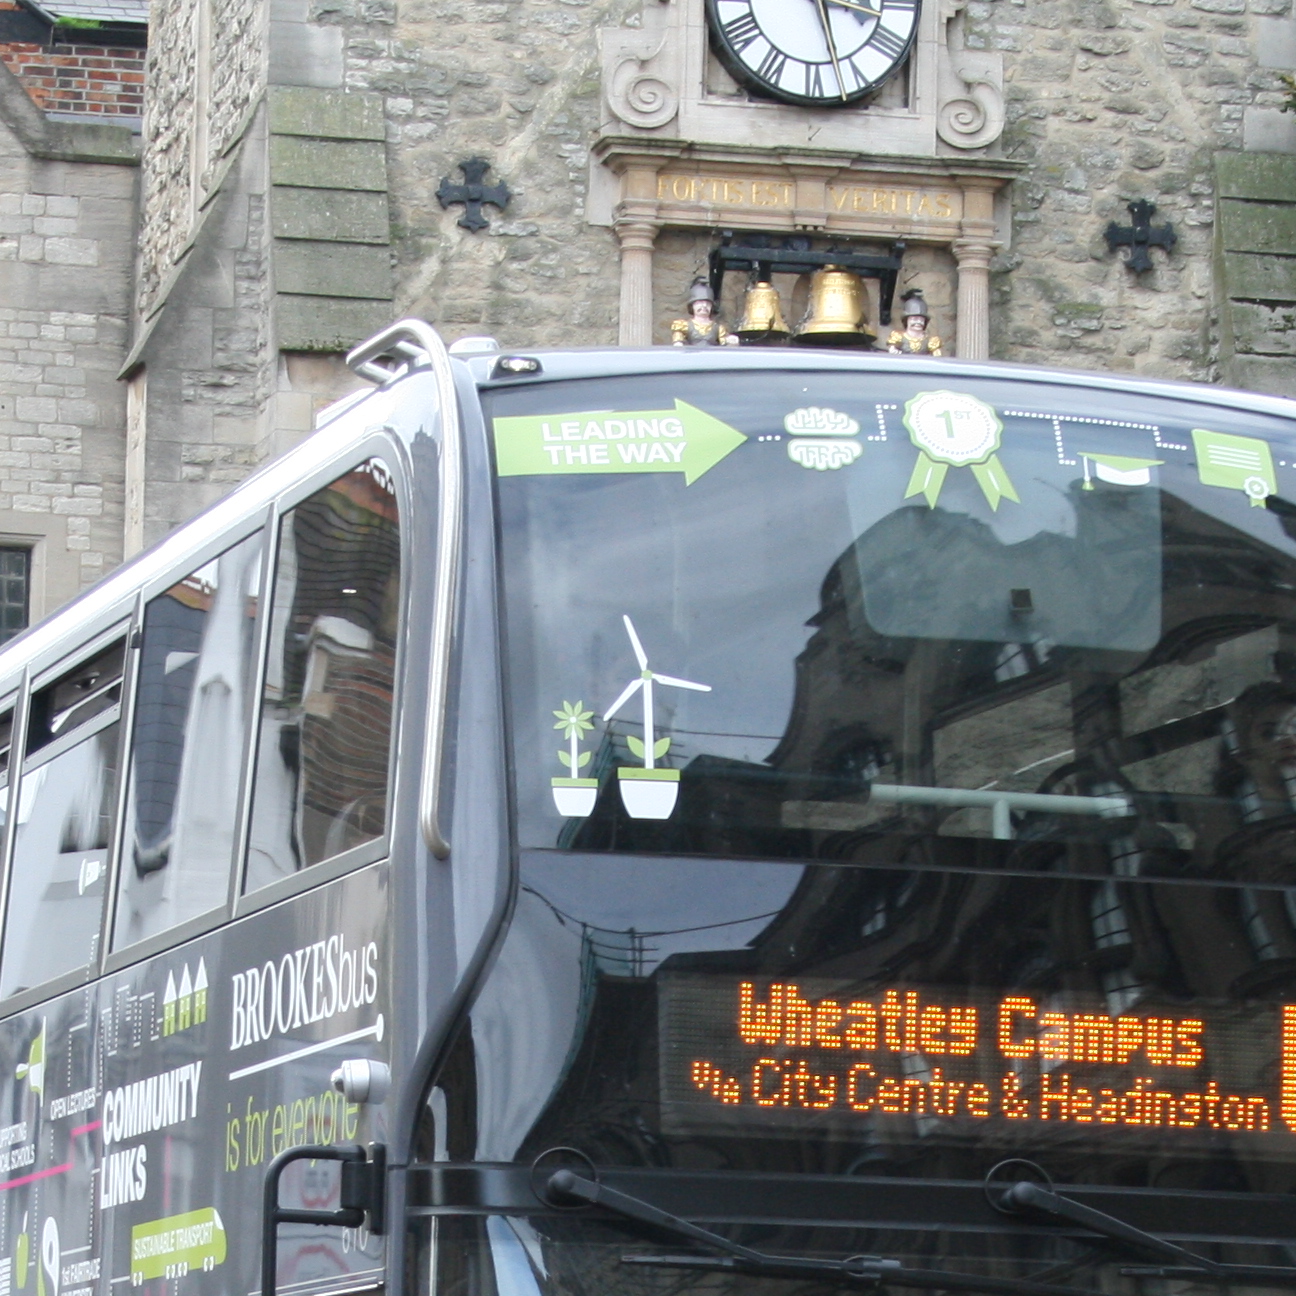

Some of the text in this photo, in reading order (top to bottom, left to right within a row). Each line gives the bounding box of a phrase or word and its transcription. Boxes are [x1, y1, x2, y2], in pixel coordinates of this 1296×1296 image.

[657, 175, 952, 218] FORTIS EST VERITAS
[542, 418, 684, 441] LEADING
[543, 442, 687, 465] THE WAY
[230, 933, 378, 1051] BROOKESbus
[738, 981, 1204, 1067] Wheatley Campus
[50, 1087, 96, 1120] OPEN LECTURES
[102, 1060, 203, 1146] COMMUNITY
[751, 1057, 836, 1111] City
[847, 1062, 990, 1118] Centre
[1001, 1070, 1030, 1120] &
[1040, 1073, 1270, 1132] Headington
[11, 1143, 36, 1170] SCHOOLS
[226, 1090, 359, 1172] is for everyone
[100, 1144, 147, 1210] LINKS
[133, 1221, 214, 1260] SUSTAINABLE TRANSPORT
